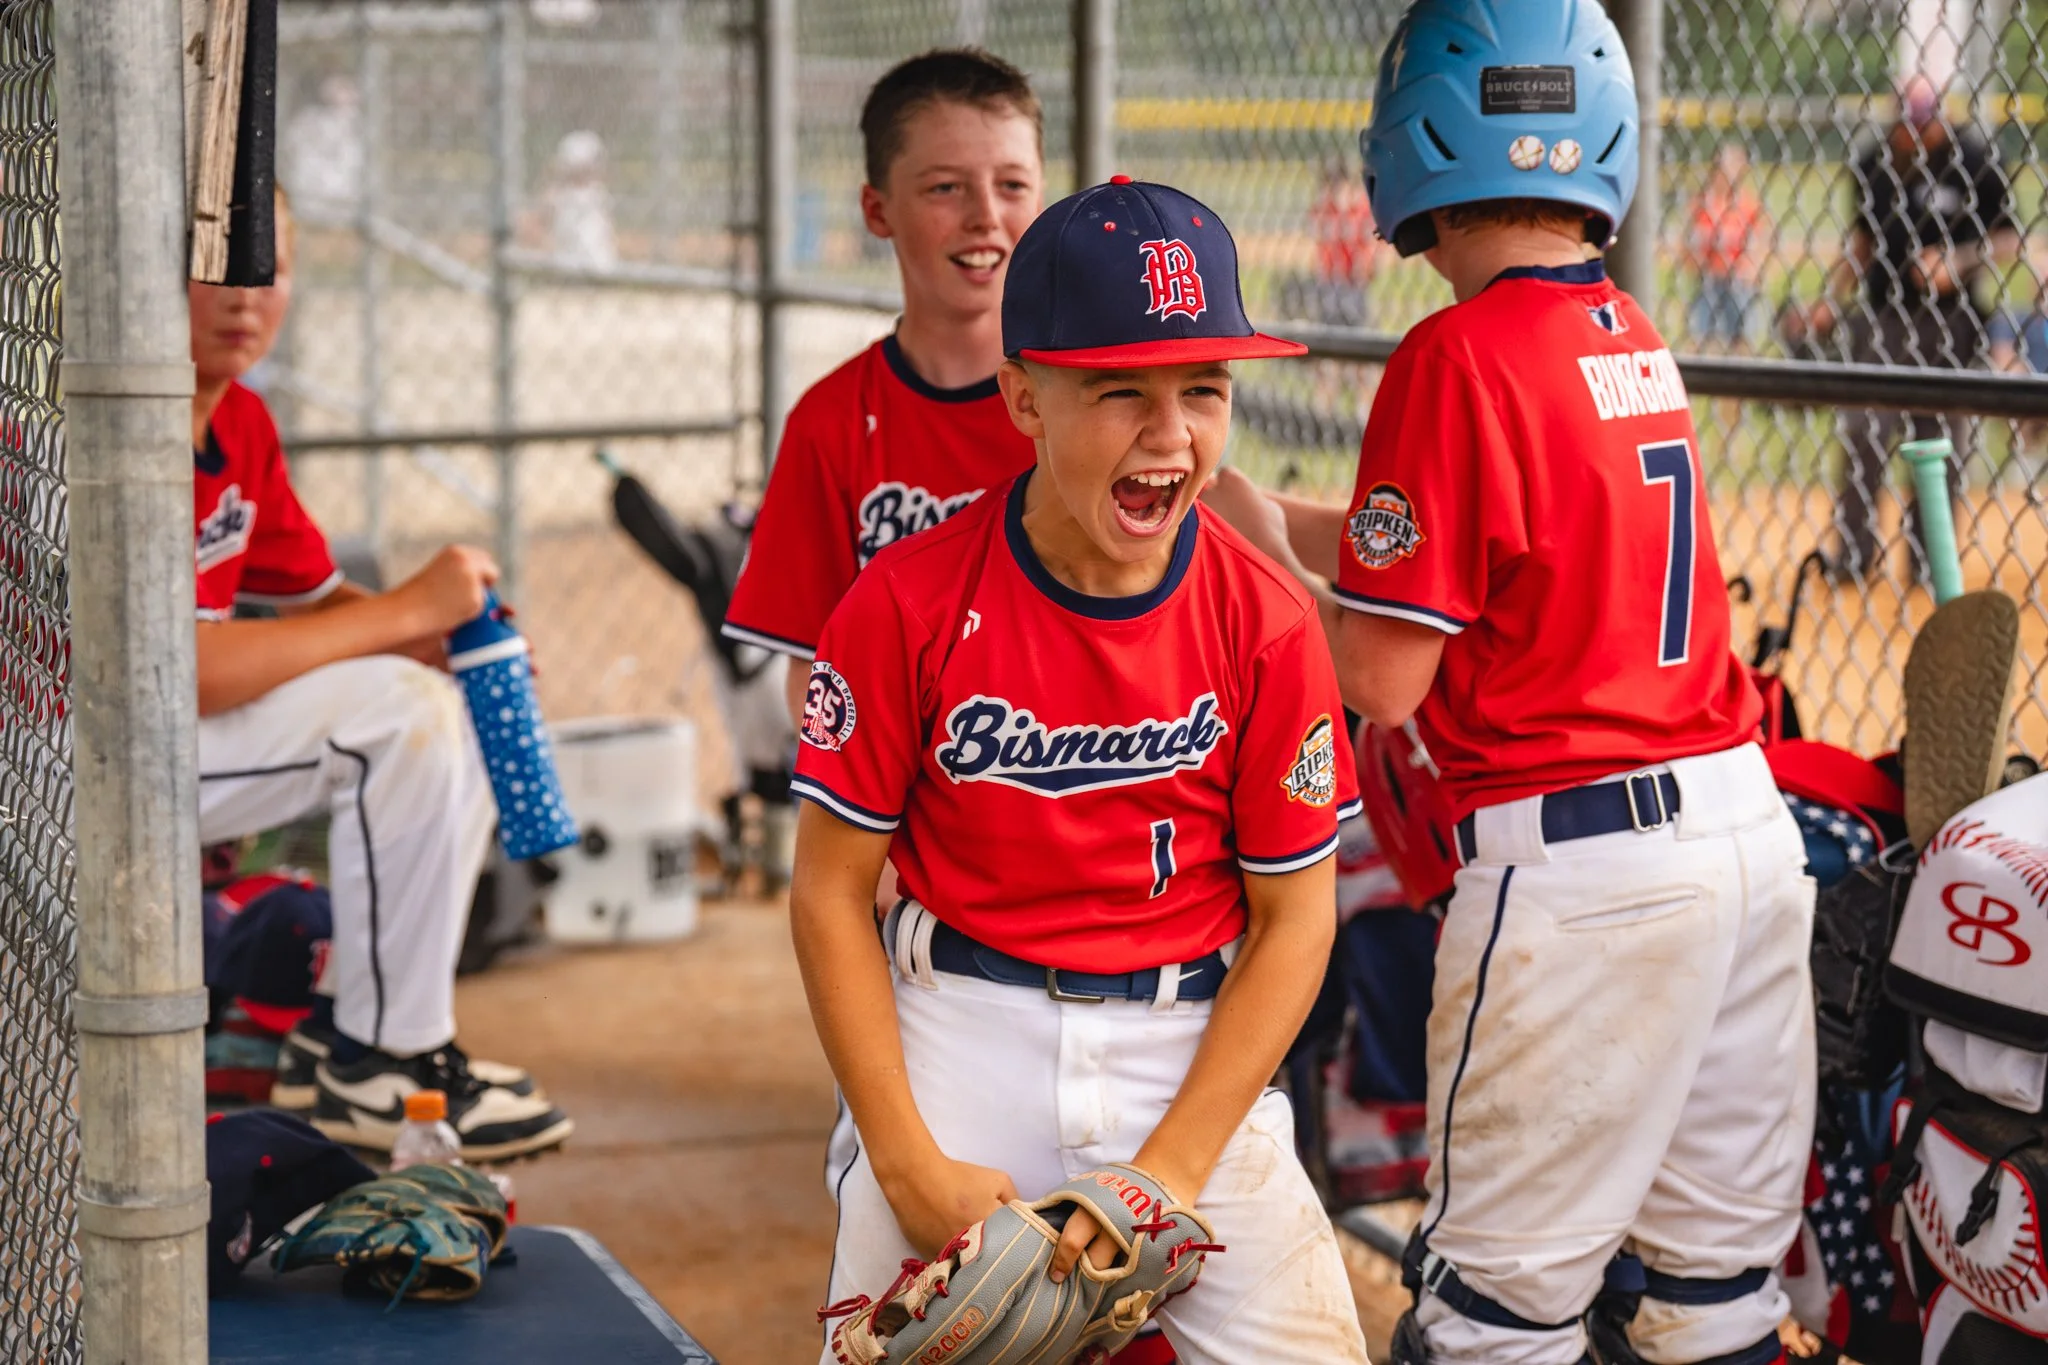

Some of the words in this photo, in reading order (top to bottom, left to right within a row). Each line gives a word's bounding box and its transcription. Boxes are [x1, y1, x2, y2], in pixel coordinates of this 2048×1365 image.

[1486, 81, 1530, 93] BRUCE
[1539, 80, 1572, 92] BOLT
[1356, 511, 1413, 543] RIPKEN
[1636, 438, 1696, 667] 7
[805, 679, 842, 728] 35
[840, 687, 855, 738] BASEBALL
[938, 695, 1226, 782] Bismarck
[1149, 818, 1177, 899] 1
[919, 1306, 985, 1365] A2000
